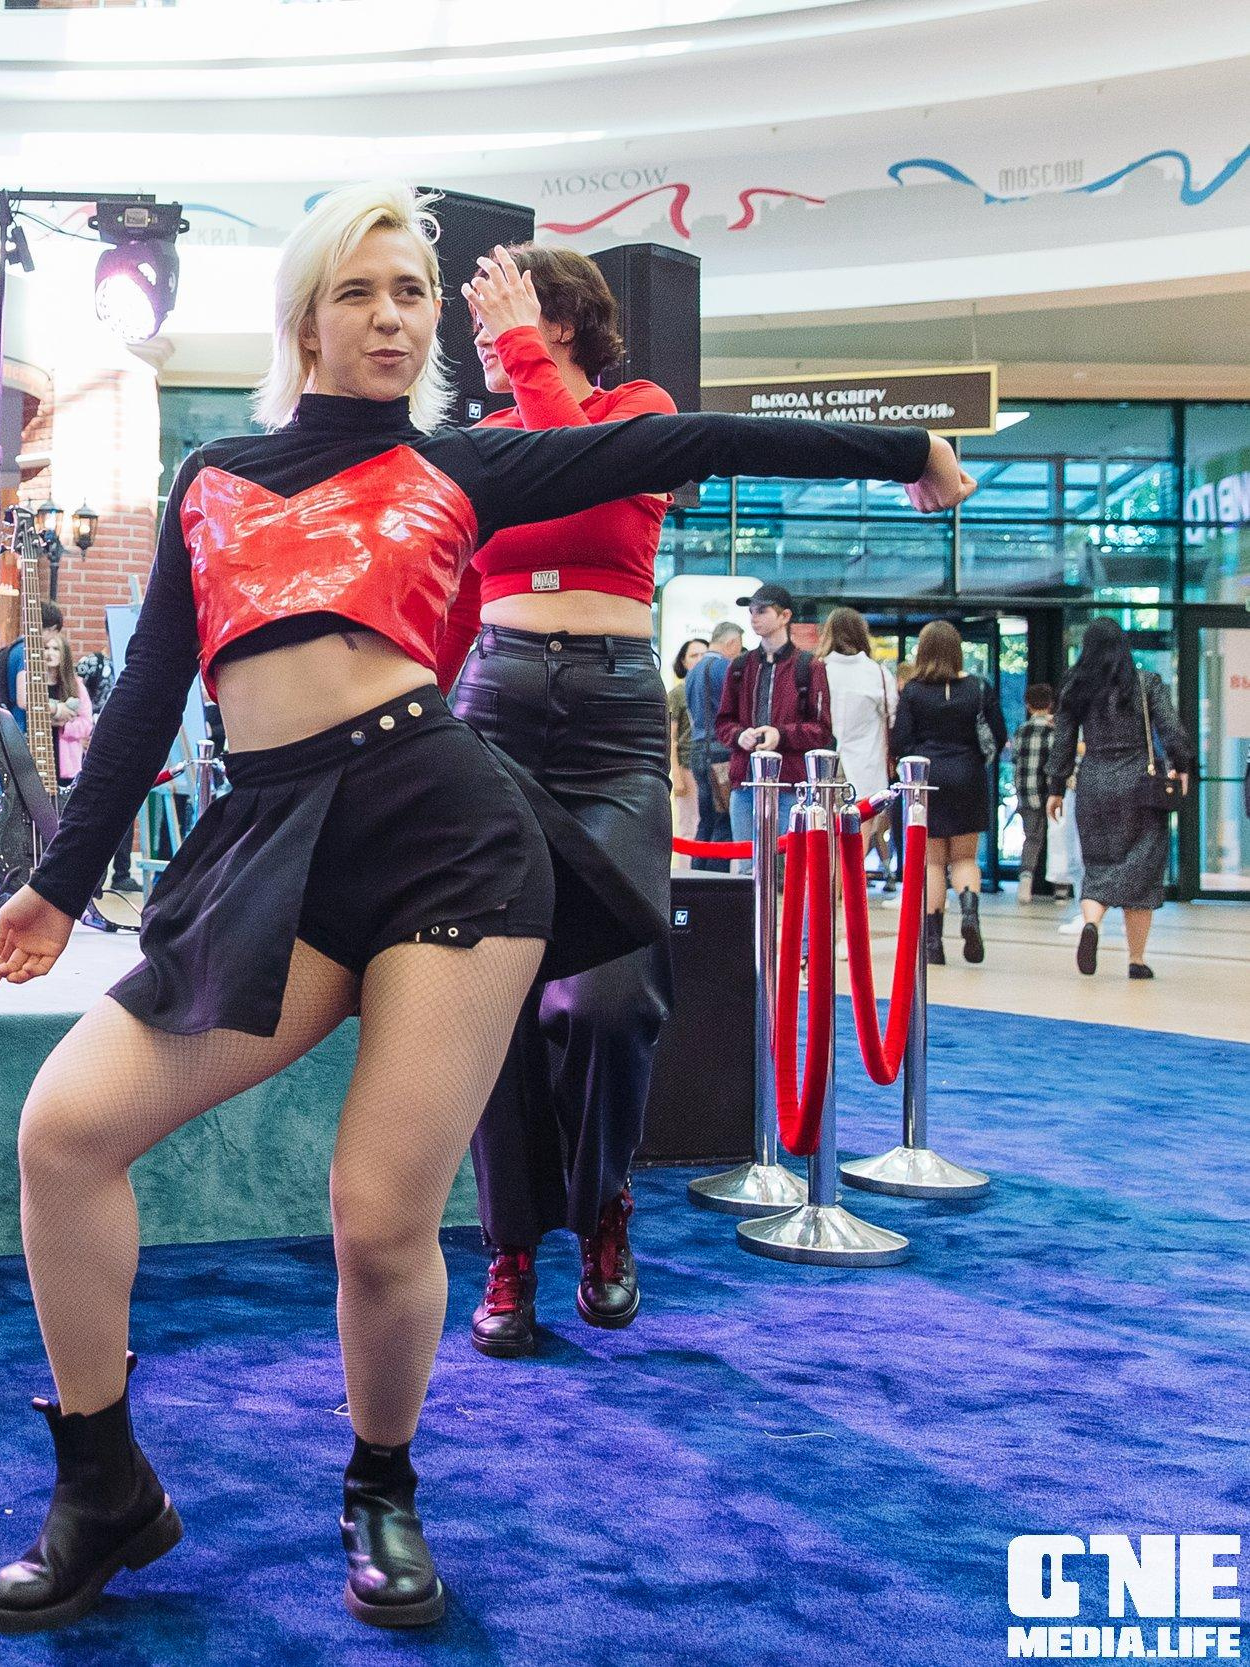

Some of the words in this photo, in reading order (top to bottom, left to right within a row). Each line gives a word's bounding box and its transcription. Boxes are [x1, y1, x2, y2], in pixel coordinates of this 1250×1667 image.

[540, 166, 668, 197] MOSCOW
[997, 160, 1083, 191] MOSCOW
[751, 391, 811, 410] ВЫХОД
[812, 391, 825, 407] К
[826, 388, 886, 408] СКВЕРУ
[824, 406, 877, 423] «МАТЬ
[879, 402, 956, 421] РОССИЯ»
[534, 572, 557, 587] NYC
